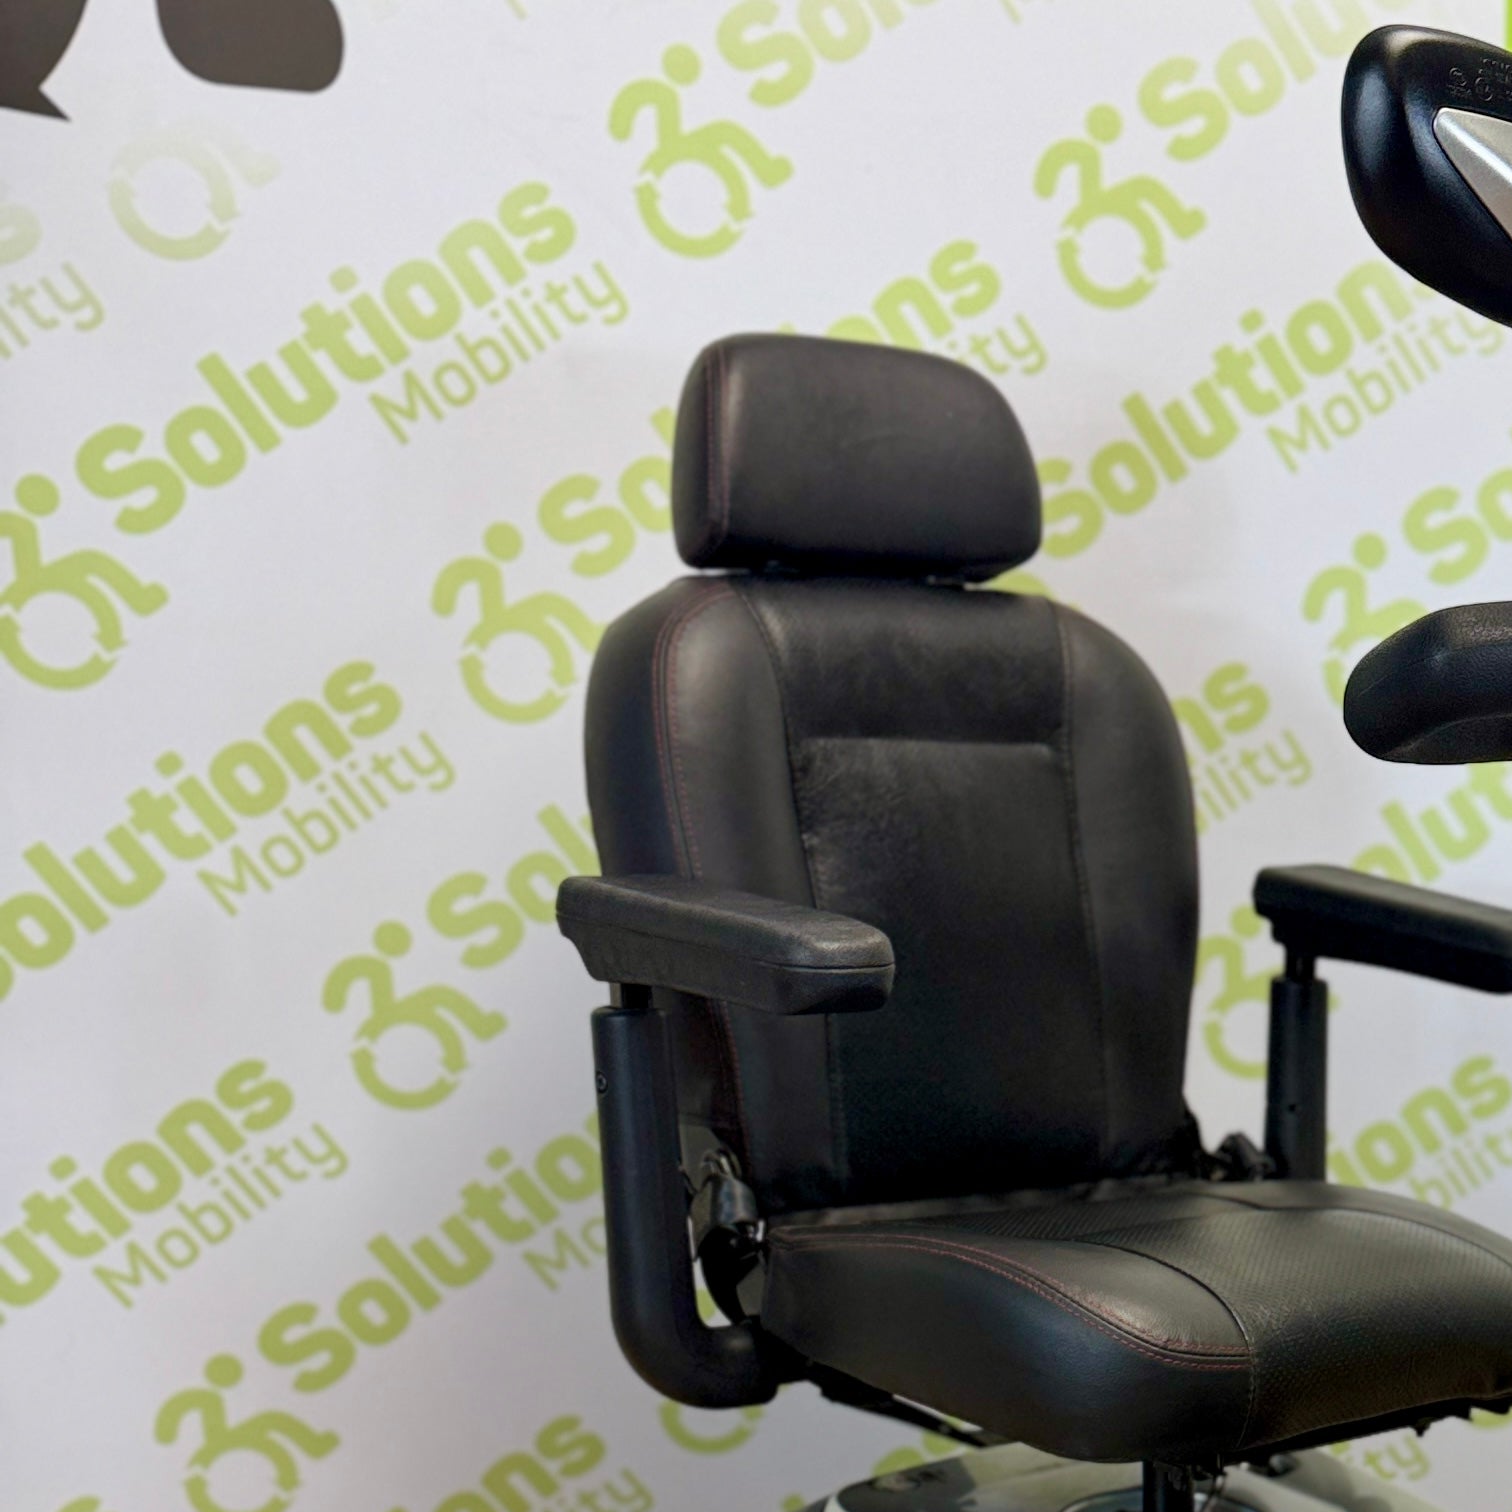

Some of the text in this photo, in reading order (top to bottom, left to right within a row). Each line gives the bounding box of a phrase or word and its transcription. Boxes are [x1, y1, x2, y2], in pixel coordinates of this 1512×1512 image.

[75, 181, 577, 535] Solutions
[368, 260, 630, 444] Mobility
[1265, 309, 1504, 473] Mobility
[0, 661, 402, 999] olutions
[197, 732, 456, 916] Mobility
[0, 1059, 294, 1307] utions
[92, 1123, 349, 1309] Mobility
[257, 1132, 603, 1393] Solutio
